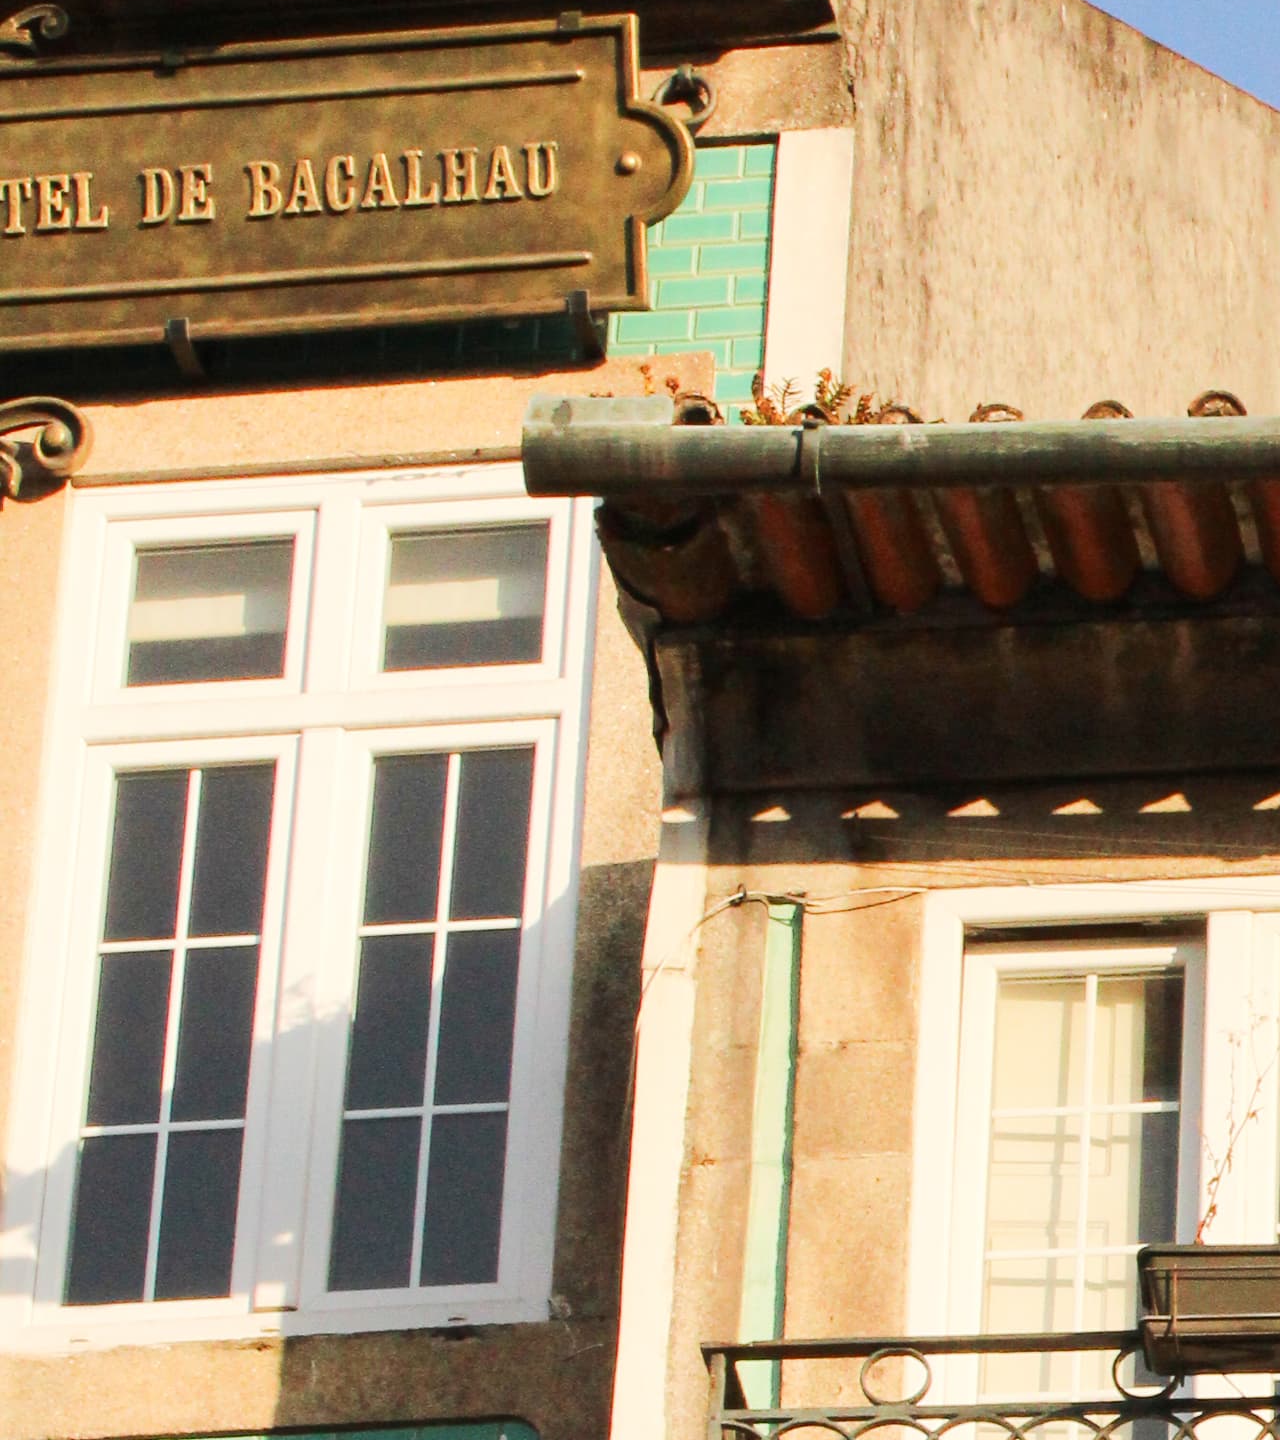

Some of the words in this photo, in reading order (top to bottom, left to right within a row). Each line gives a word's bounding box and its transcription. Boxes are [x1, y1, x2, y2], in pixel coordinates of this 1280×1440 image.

[0, 172, 109, 234] TEL
[140, 163, 216, 224] DE
[246, 140, 560, 217] BACALHAU
